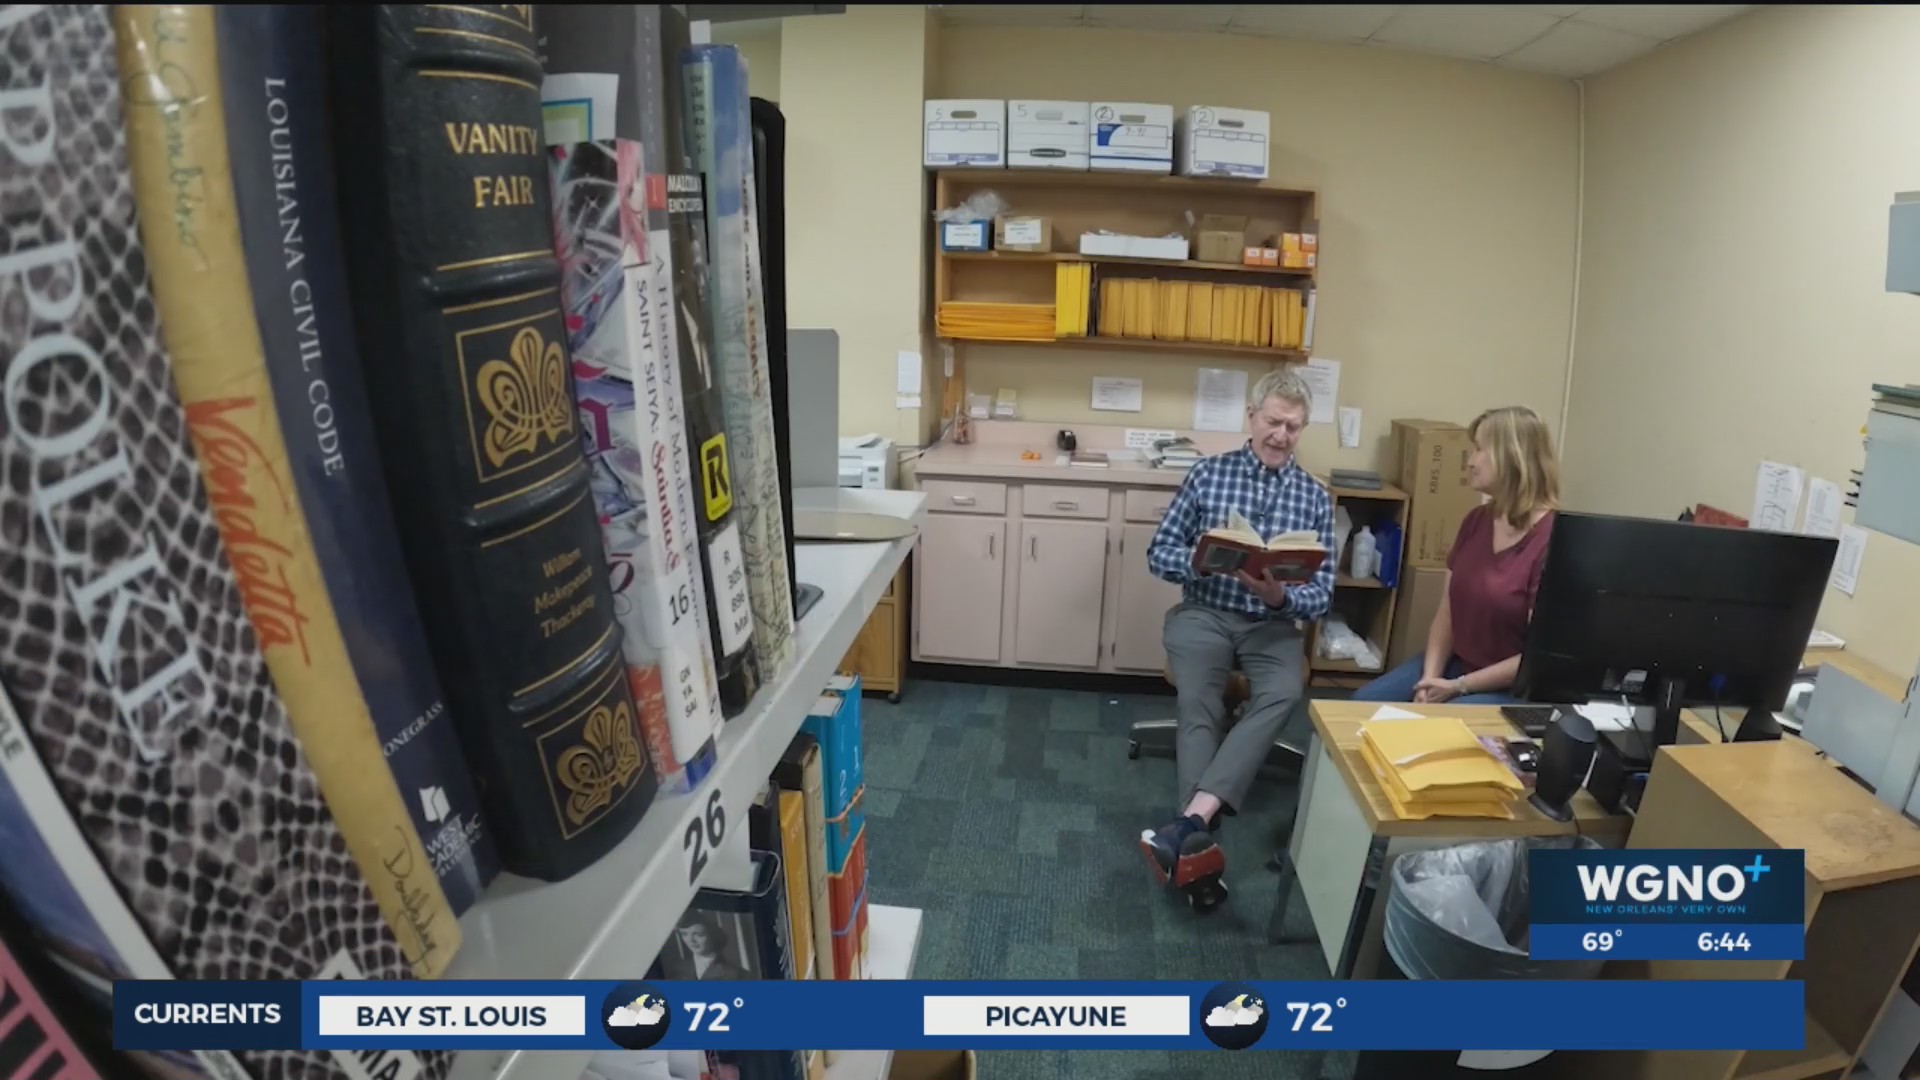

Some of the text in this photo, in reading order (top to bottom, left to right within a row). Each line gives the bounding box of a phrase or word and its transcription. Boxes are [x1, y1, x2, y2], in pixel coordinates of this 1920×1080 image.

[445, 122, 538, 156] VANITY
[473, 176, 534, 208] FAIR
[264, 76, 345, 477] LOUISIANA CIVIL CODE
[637, 280, 652, 349] SAINT
[0, 234, 214, 762] POLKE
[672, 432, 688, 535] Modern
[706, 445, 729, 499] R
[186, 397, 311, 667] Vendetta
[668, 584, 689, 626] 16
[427, 813, 462, 855] WEST
[683, 788, 726, 887] 26
